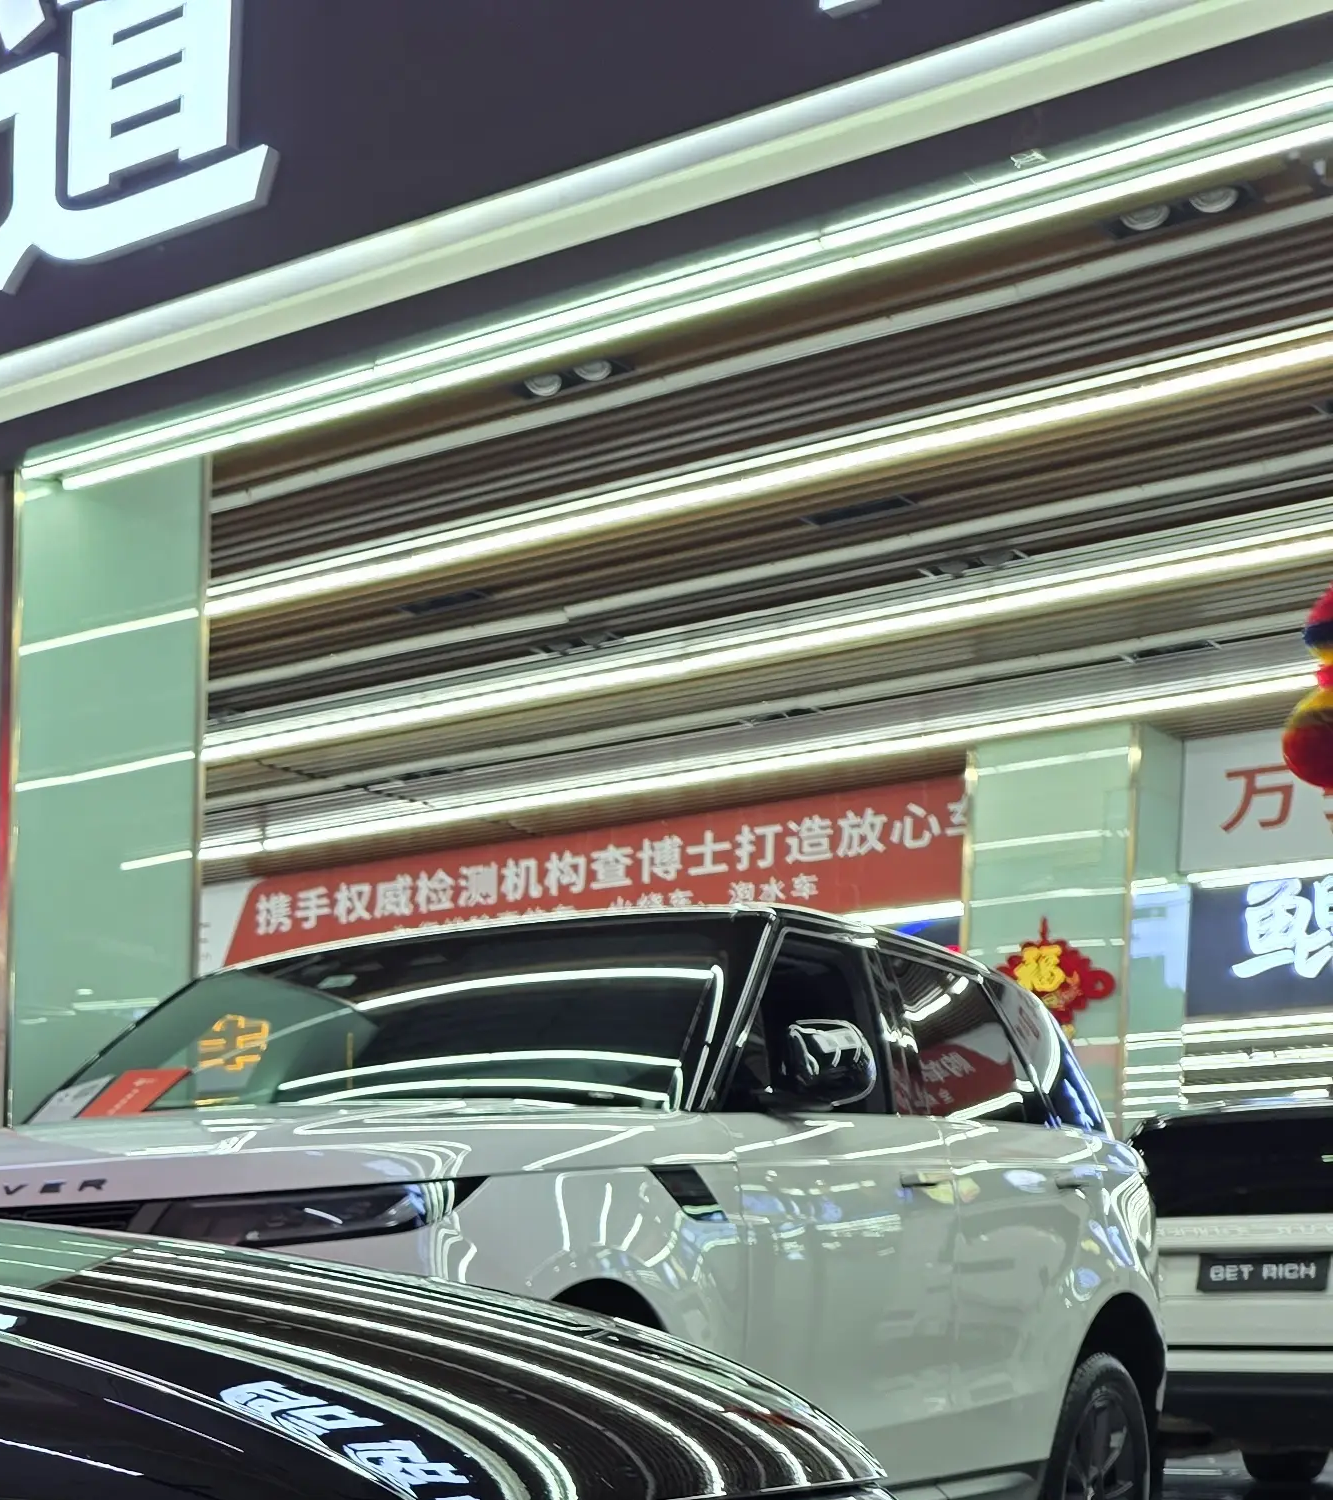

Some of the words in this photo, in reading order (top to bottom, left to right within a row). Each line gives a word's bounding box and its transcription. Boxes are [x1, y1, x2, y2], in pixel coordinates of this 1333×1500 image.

[1220, 764, 1333, 834] 万
[1209, 1264, 1254, 1282] GET
[1261, 1262, 1317, 1281] RICH
